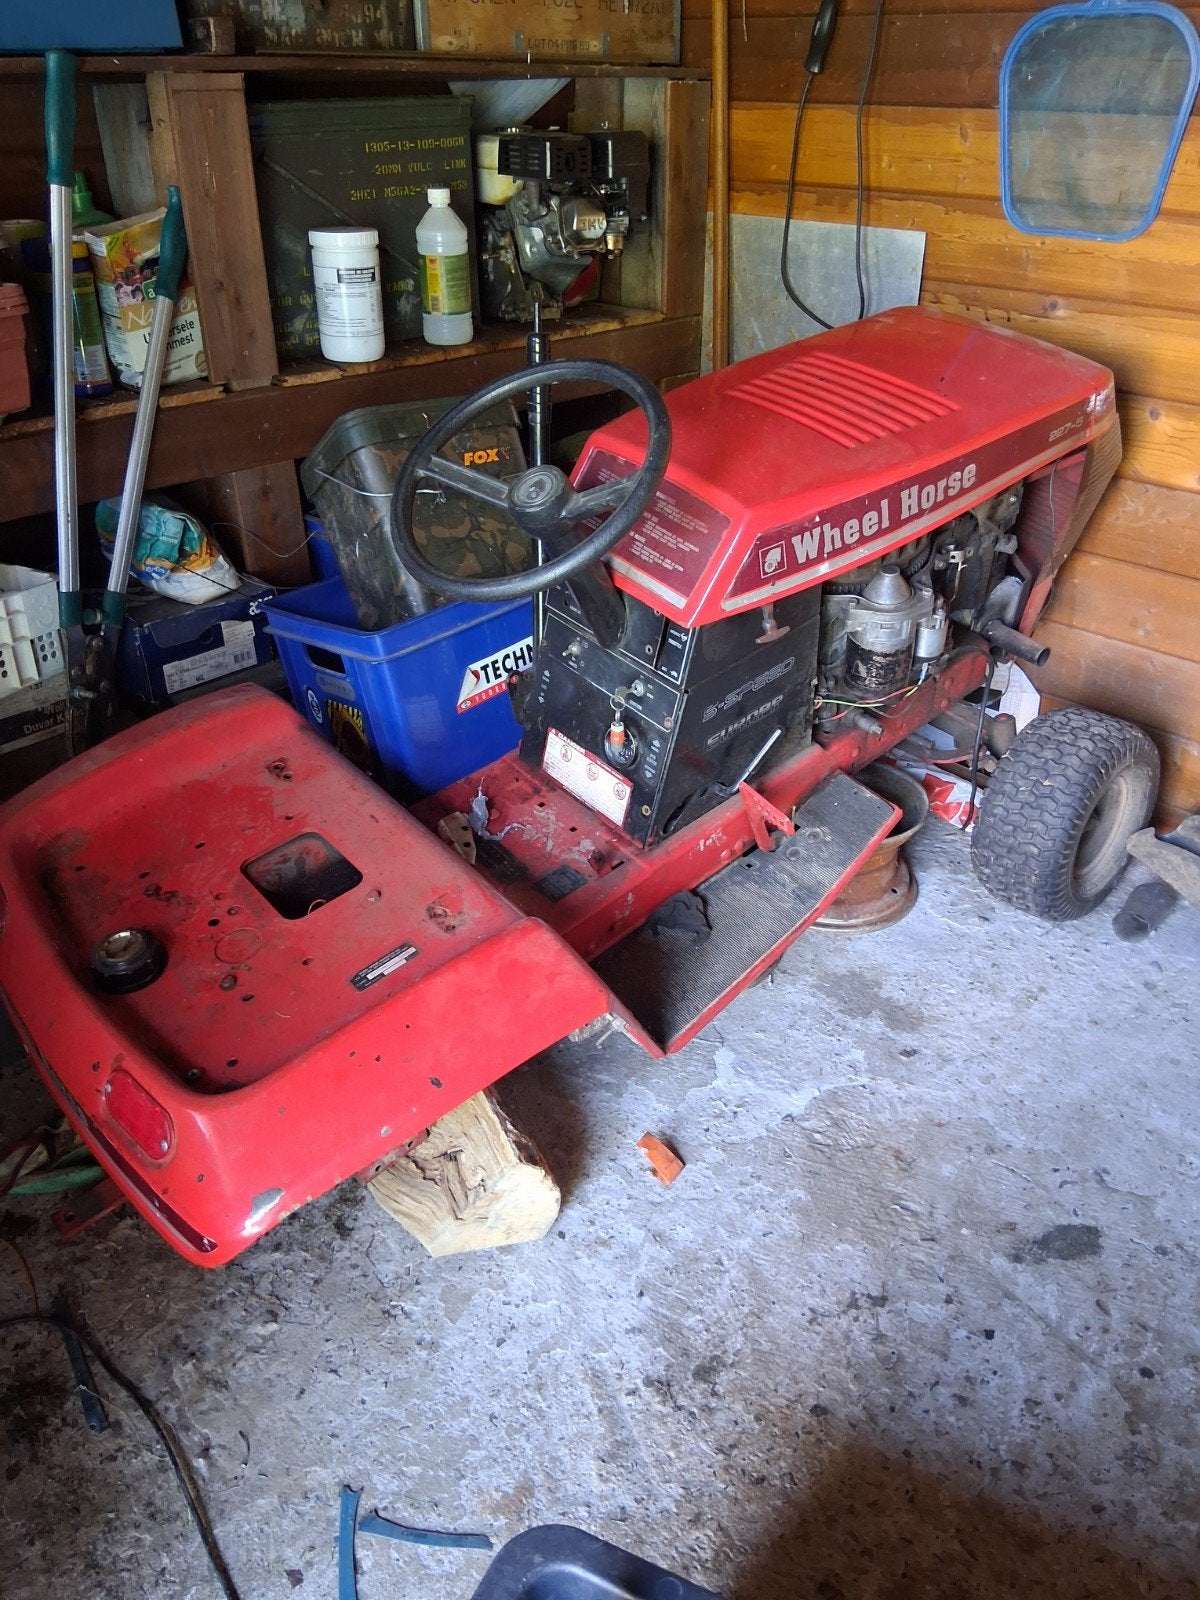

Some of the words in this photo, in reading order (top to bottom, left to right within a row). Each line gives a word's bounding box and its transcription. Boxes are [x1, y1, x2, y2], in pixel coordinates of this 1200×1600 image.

[142, 318, 196, 344] Uersele
[463, 448, 500, 467] FOX
[791, 498, 889, 565] Wheel
[899, 463, 977, 521] Horse
